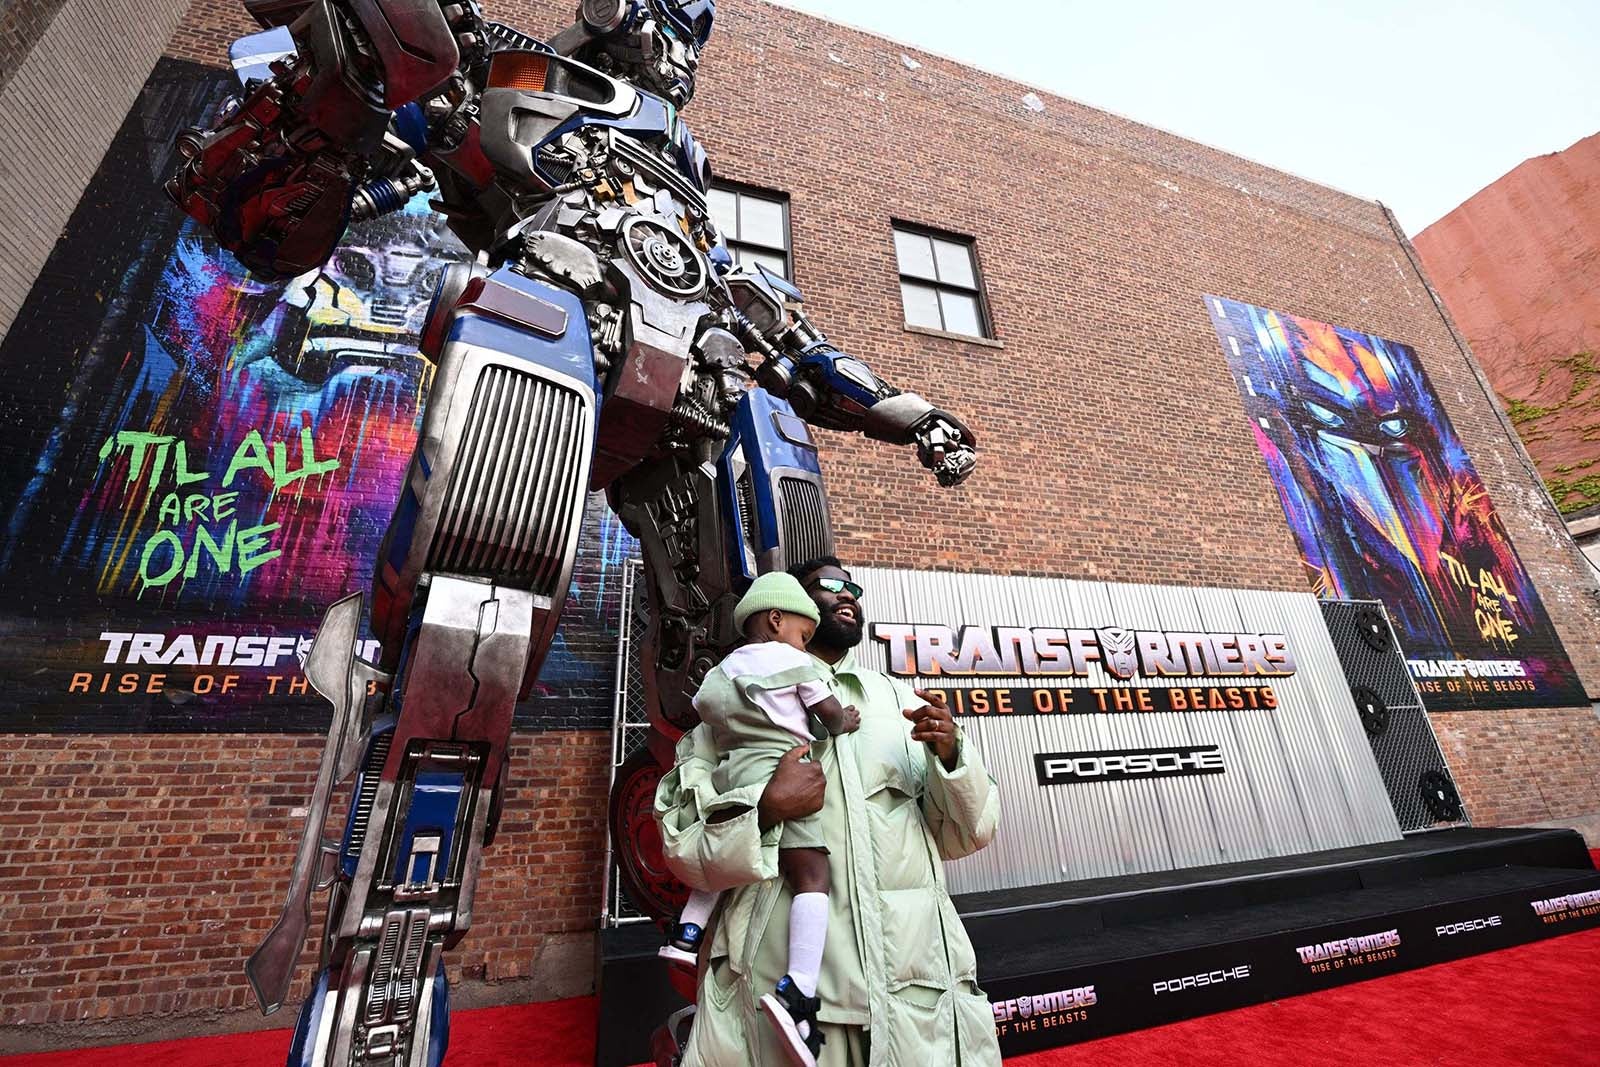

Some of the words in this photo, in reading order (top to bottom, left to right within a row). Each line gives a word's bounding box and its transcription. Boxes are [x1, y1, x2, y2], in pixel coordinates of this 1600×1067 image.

[222, 427, 340, 488] ALL
[159, 491, 239, 525] ARE
[140, 518, 281, 587] ONE
[1480, 568, 1517, 602] ALL
[1477, 593, 1502, 612] ARE
[1475, 608, 1518, 643] ONE
[870, 621, 1297, 680] TRANSFORMERS
[1406, 659, 1526, 678] TRANSFORMERS
[69, 673, 166, 693] RISE
[193, 675, 239, 694] OF
[267, 676, 320, 695] TH
[1447, 681, 1461, 692] OF
[1466, 681, 1490, 692] THE
[1494, 681, 1536, 692] BEASTS
[1032, 689, 1074, 714] OF
[1094, 689, 1154, 712] THE
[1168, 687, 1278, 711] BEASTS
[1043, 750, 1225, 779] PORSCHE
[1435, 915, 1502, 937] PORSCHE
[1296, 929, 1401, 964] TRANSFORMERS
[1311, 962, 1332, 974] RISE
[1334, 959, 1345, 969] OF
[1348, 956, 1364, 967] THE
[1367, 949, 1397, 962] BEASTS
[1153, 965, 1250, 995] PORSCHE
[1014, 1020, 1037, 1033] THE
[1043, 1010, 1088, 1028] BEASTS
